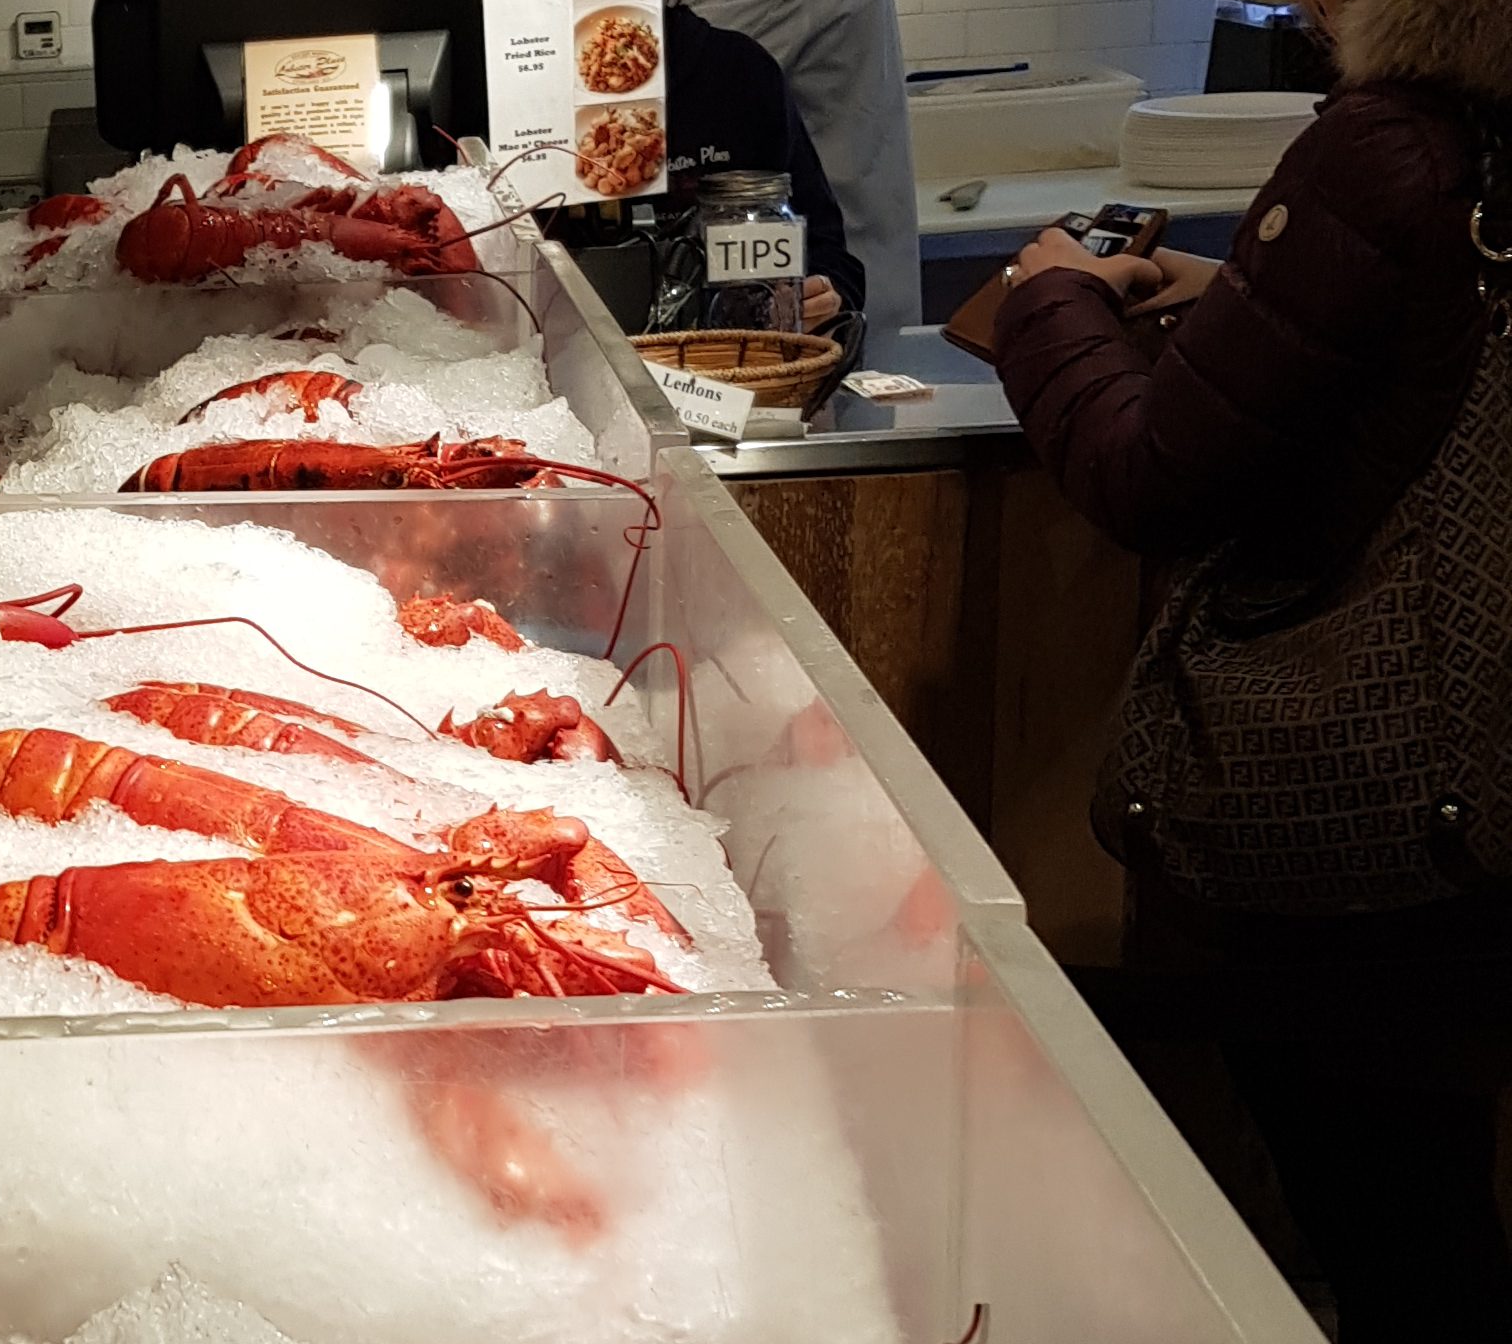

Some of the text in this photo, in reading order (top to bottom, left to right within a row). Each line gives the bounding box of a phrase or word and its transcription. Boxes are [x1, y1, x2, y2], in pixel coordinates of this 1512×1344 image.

[510, 36, 550, 46] Lobster
[505, 49, 556, 60] Fried Rice
[514, 128, 553, 137] Lobster
[498, 143, 520, 152] Mac
[534, 138, 569, 148] Cheese
[715, 239, 791, 270] TIPS
[662, 372, 723, 402] Lemons
[684, 410, 709, 426] 0.50
[711, 420, 738, 434] each
